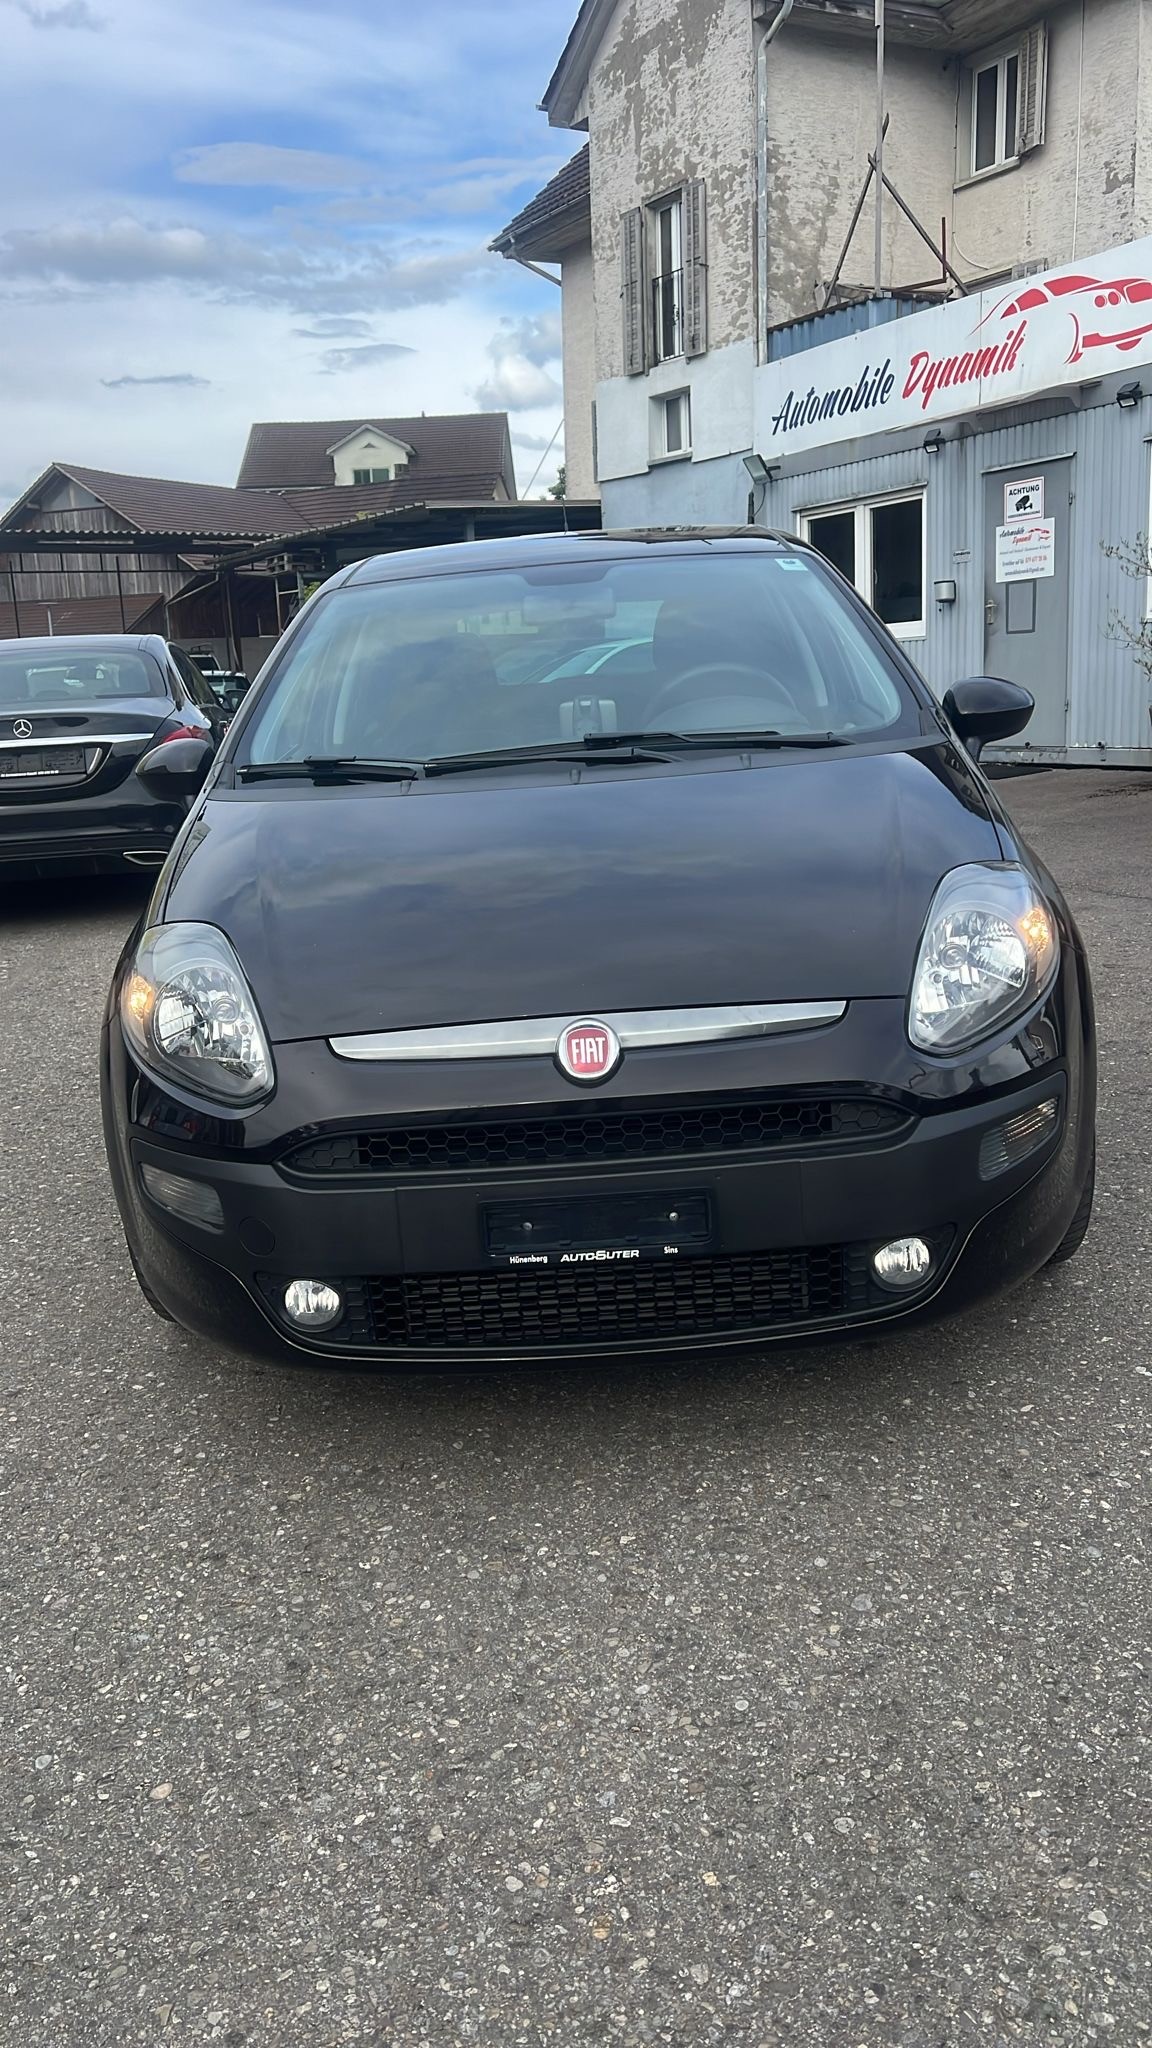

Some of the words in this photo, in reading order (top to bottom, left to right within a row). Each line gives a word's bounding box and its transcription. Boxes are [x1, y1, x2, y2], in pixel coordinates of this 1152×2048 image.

[771, 358, 896, 436] Automobile
[902, 319, 1028, 410] Dynamik
[1008, 484, 1040, 496] ACHTUNG
[571, 1037, 606, 1064] FIAT
[509, 1254, 548, 1264] Hünenberg
[663, 1245, 679, 1255] Sins
